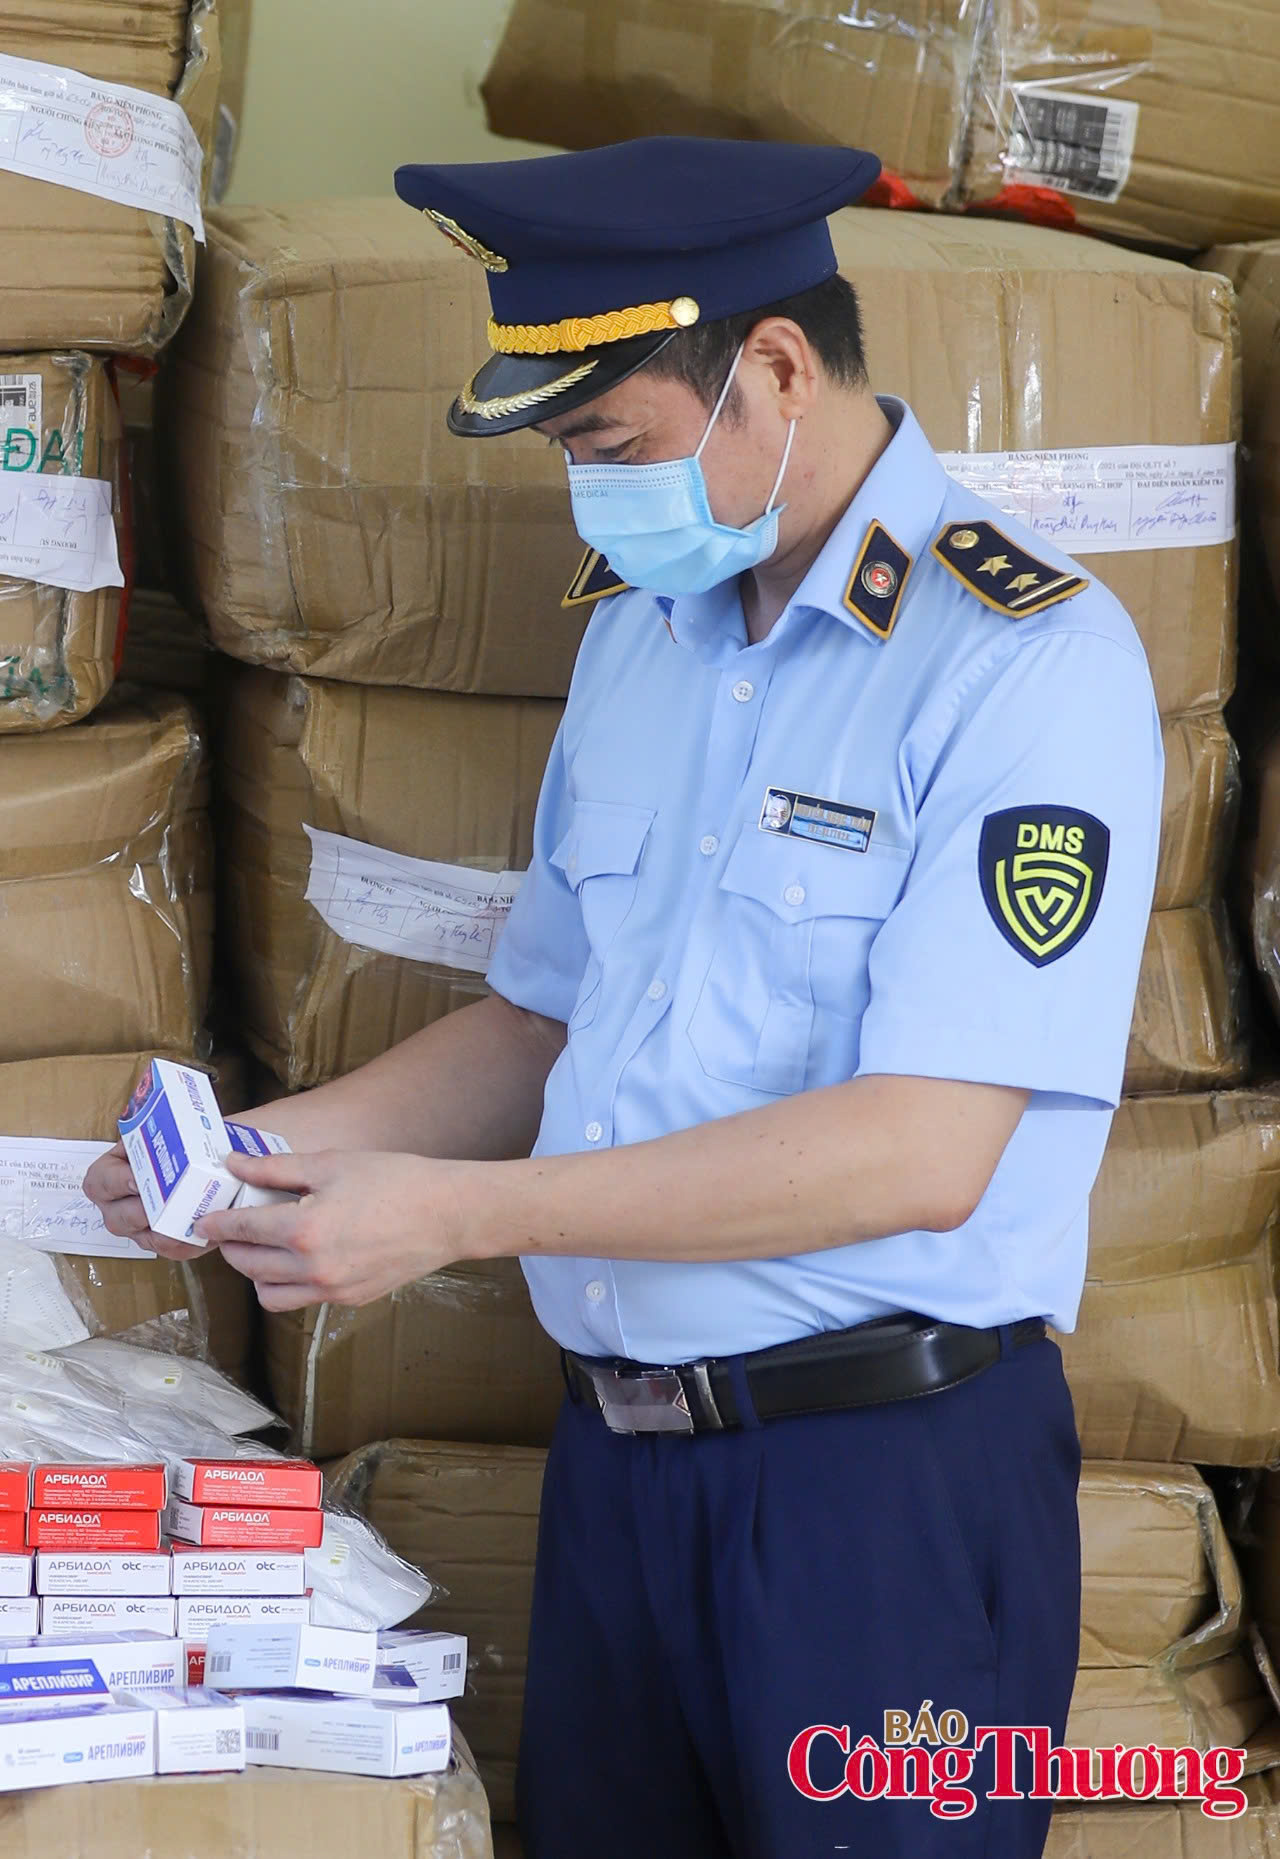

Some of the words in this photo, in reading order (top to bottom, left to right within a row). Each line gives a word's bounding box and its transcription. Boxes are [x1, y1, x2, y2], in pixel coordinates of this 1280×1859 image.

[1017, 823, 1085, 854] DMS
[44, 1473, 108, 1487] АРБИДОЛ
[203, 1469, 266, 1483] АРБИДОЛ
[38, 1512, 102, 1526] АРБИДОЛ
[212, 1511, 271, 1524] АРБИДОЛ
[48, 1560, 112, 1572] АРБИДОЛ
[121, 1561, 142, 1571] otc
[183, 1560, 247, 1572] АРБИДОЛ
[256, 1561, 276, 1571] otc
[52, 1602, 116, 1614] АРБИДОЛ
[125, 1603, 146, 1614] otc
[187, 1603, 251, 1615] АРБИДОЛ
[260, 1603, 281, 1615] otc
[323, 1657, 371, 1673] АРЕПЛИВИР
[11, 1673, 95, 1692] АРЕПЛИВИР
[108, 1668, 176, 1687] АРЕПЛИВИР
[87, 1740, 147, 1761] АРЕПЛИВИР
